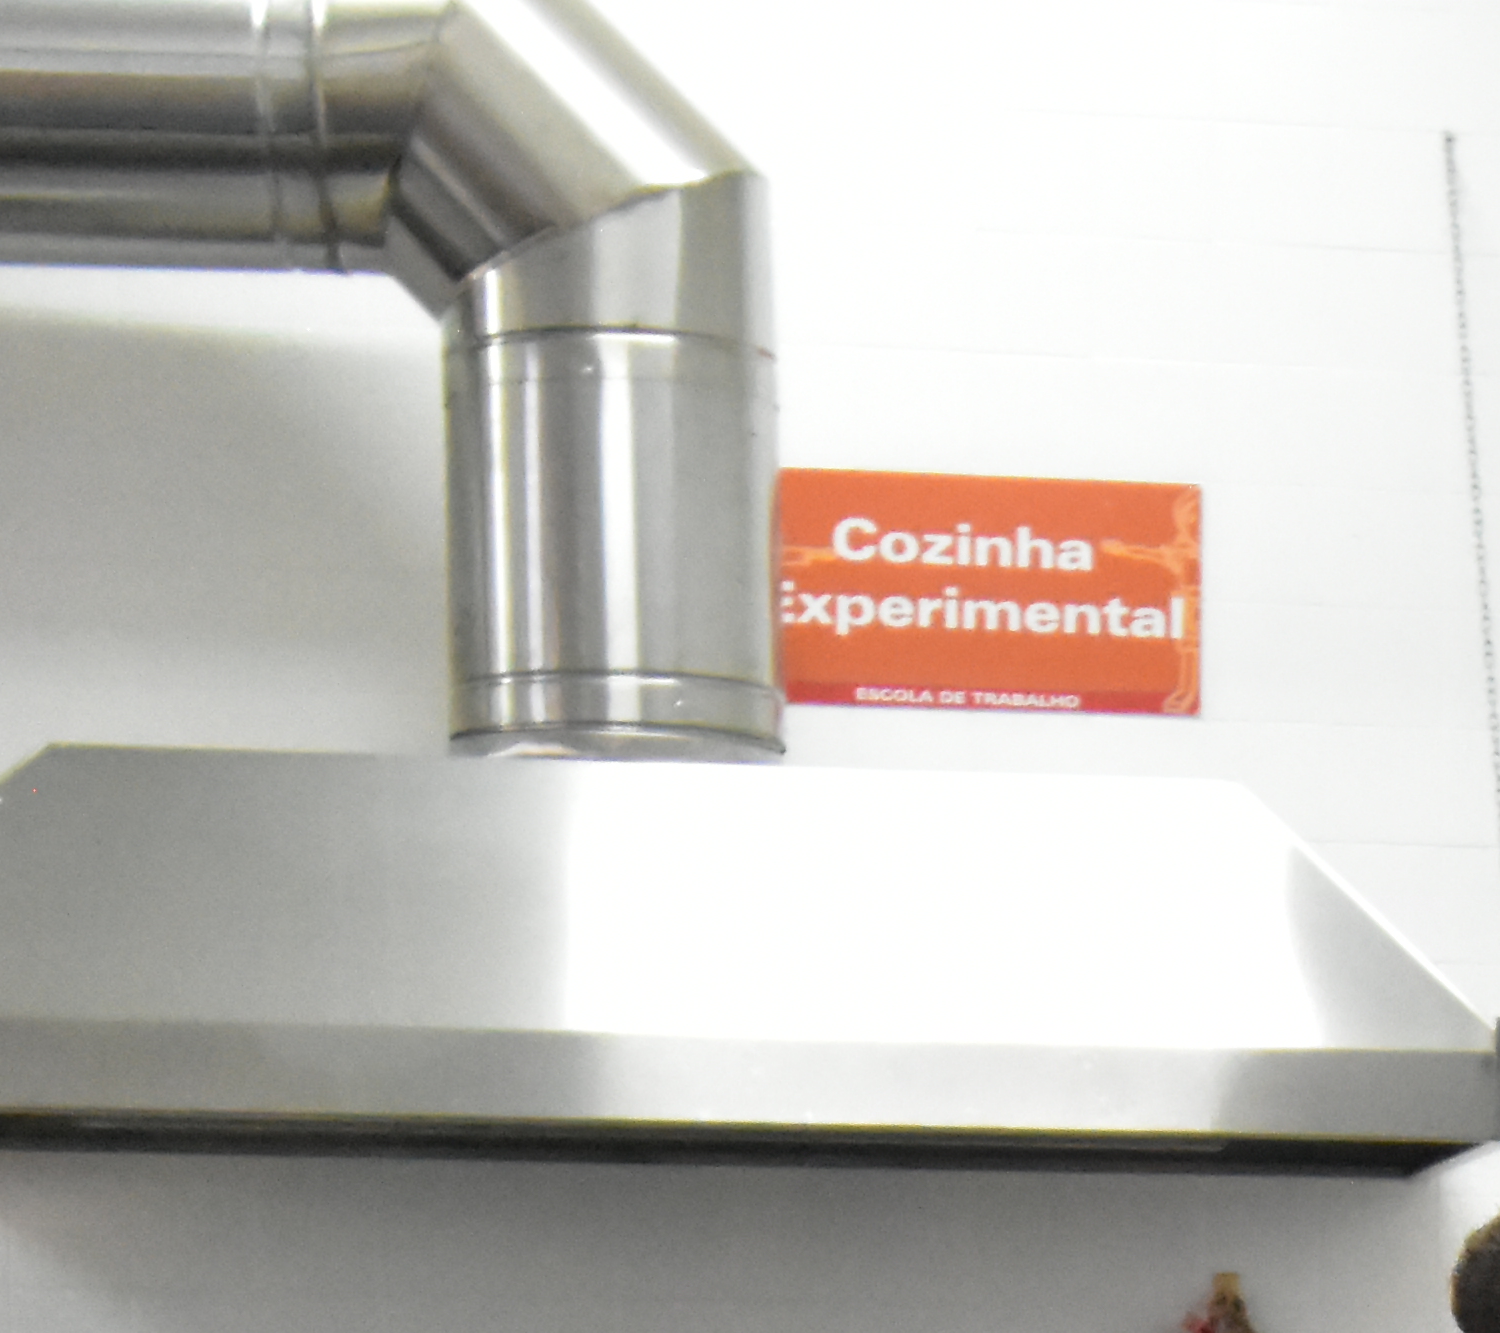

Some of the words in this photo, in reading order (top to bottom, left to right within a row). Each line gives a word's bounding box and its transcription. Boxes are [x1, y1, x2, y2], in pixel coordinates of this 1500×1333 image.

[831, 516, 1095, 572] Cozinha
[856, 687, 933, 703] ESCOLA
[940, 690, 965, 704] DE
[973, 692, 1081, 708] TRABALHO
